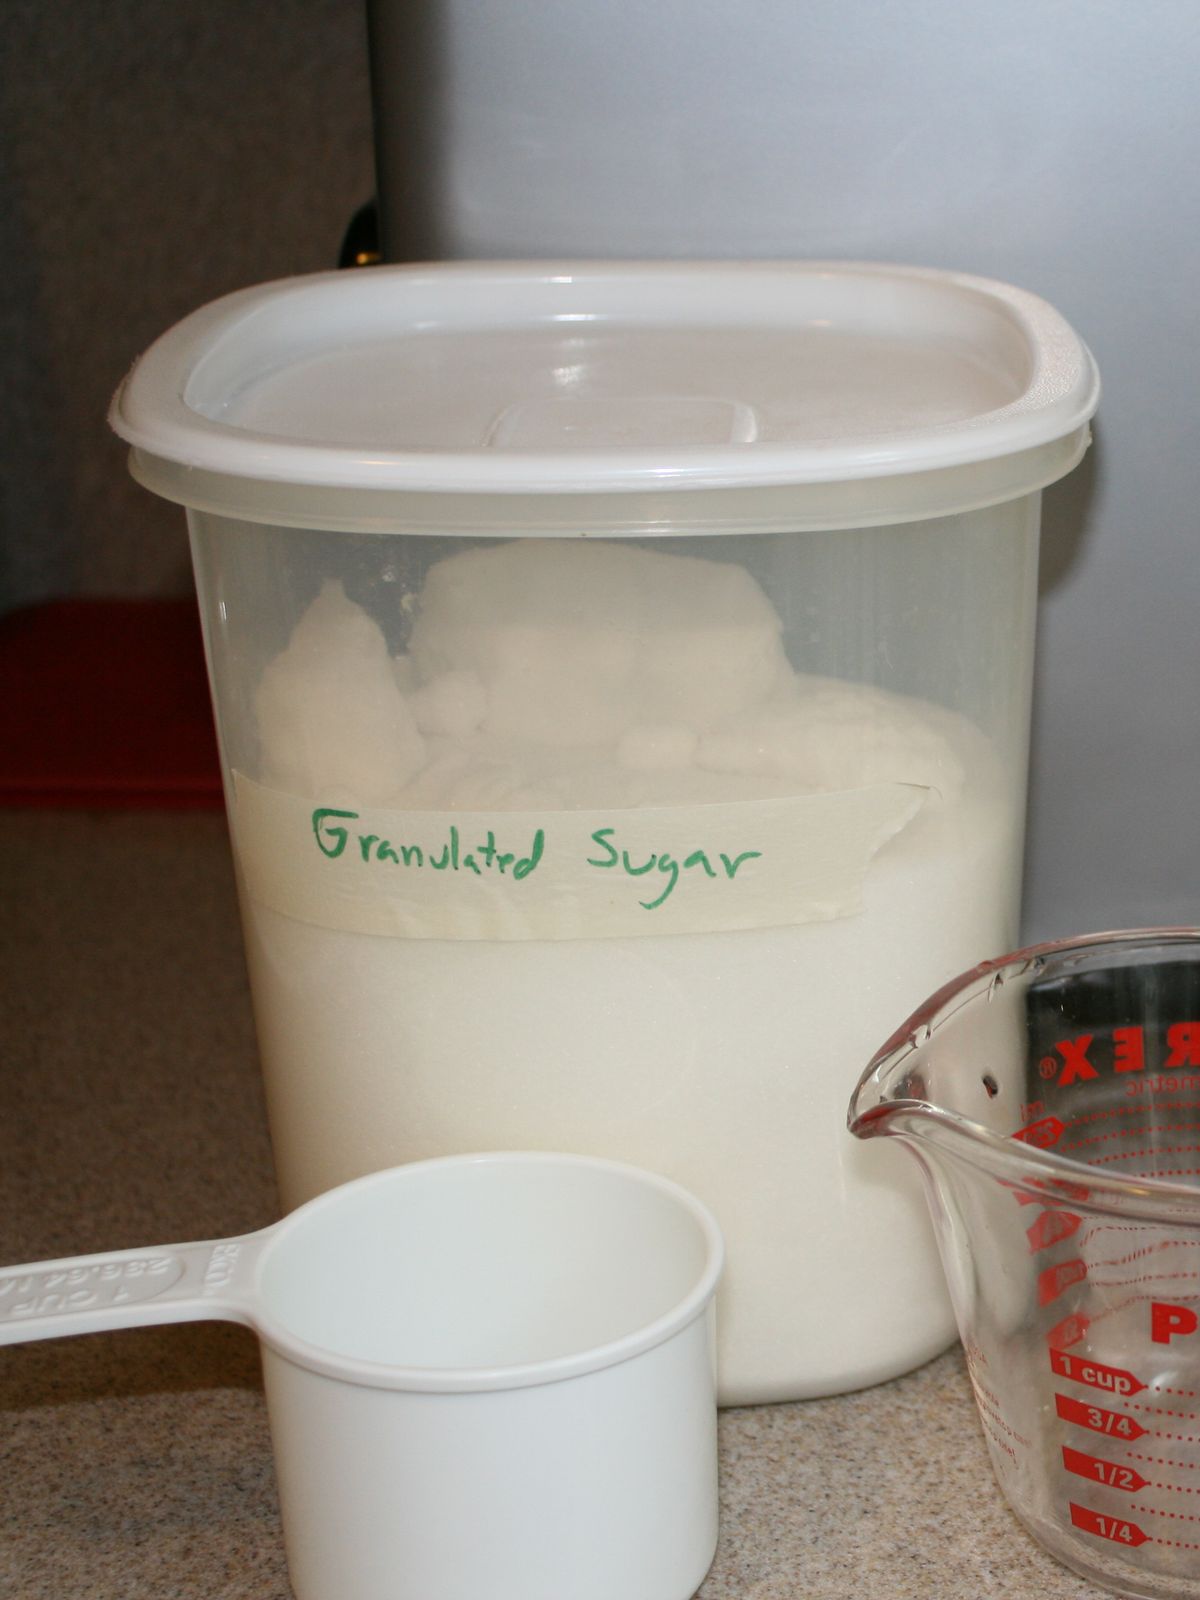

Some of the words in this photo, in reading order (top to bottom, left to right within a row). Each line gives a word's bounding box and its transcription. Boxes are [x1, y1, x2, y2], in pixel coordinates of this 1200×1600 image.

[313, 808, 544, 879] Granulated
[587, 828, 762, 909] Sugar
[1059, 1357, 1073, 1375] 1
[1082, 1367, 1132, 1396] cup
[1088, 1408, 1132, 1436] 3/4
[1094, 1462, 1134, 1490] 1/2
[1097, 1516, 1134, 1542] 1/4
